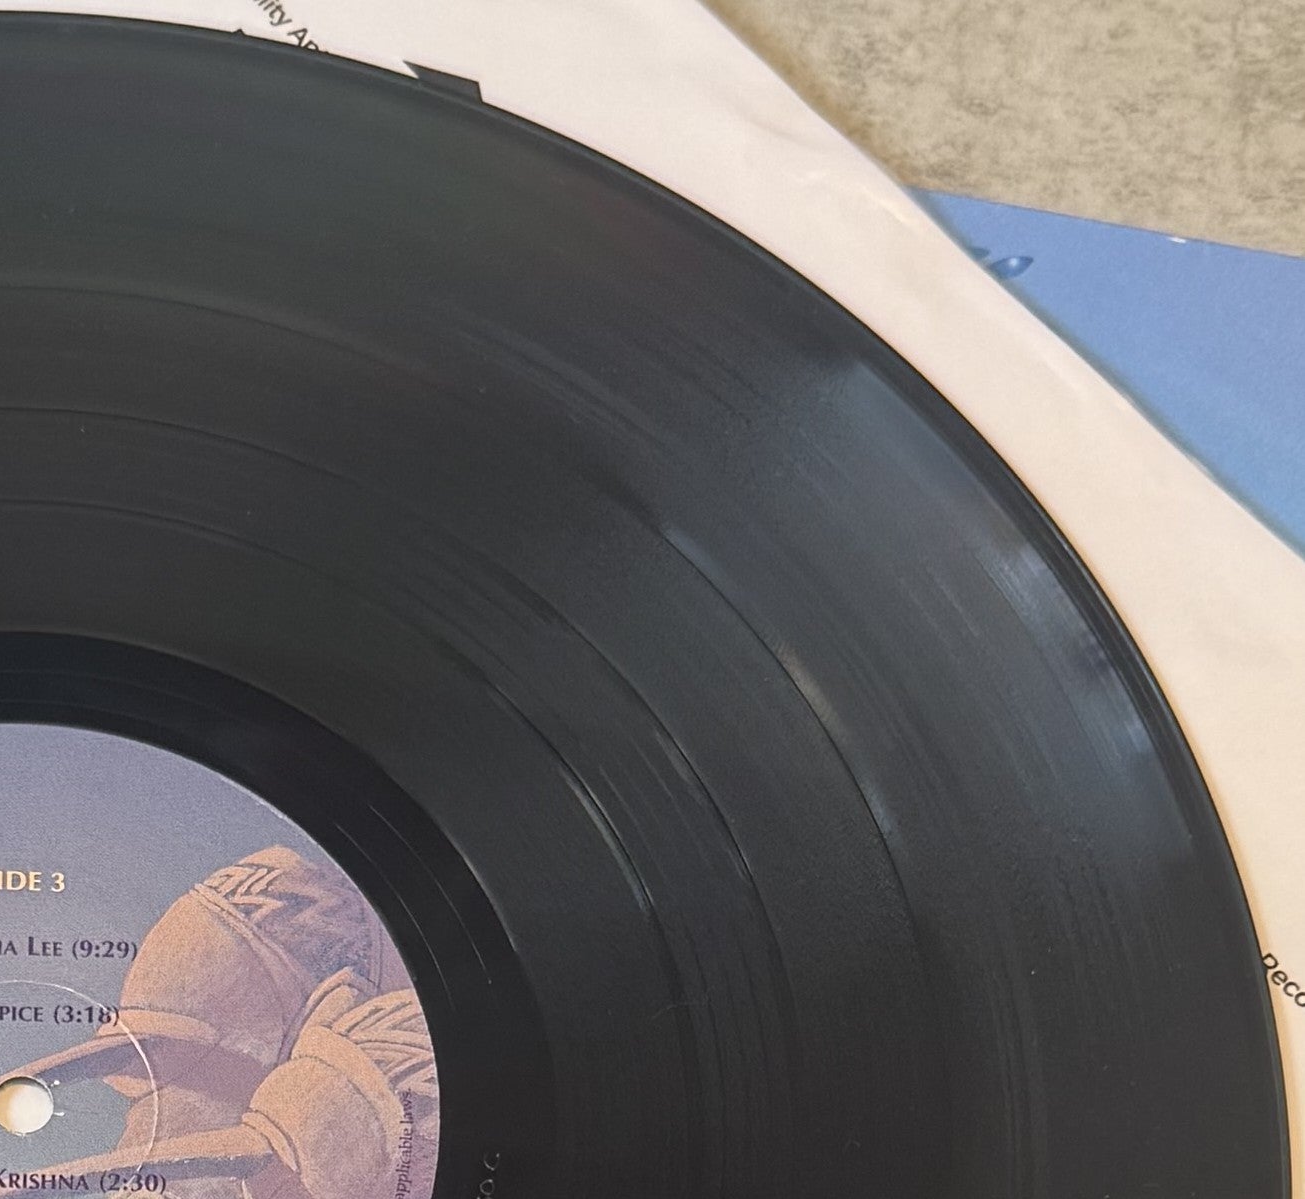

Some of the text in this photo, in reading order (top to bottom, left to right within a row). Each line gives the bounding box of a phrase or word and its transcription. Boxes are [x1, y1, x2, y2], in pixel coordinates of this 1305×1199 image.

[50, 872, 66, 893] 3
[27, 936, 63, 957] LEE
[71, 938, 138, 960] (9:29)
[53, 1004, 120, 1026] (3:18)
[399, 1088, 413, 1124] laws.
[99, 1171, 167, 1194] (2:30)
